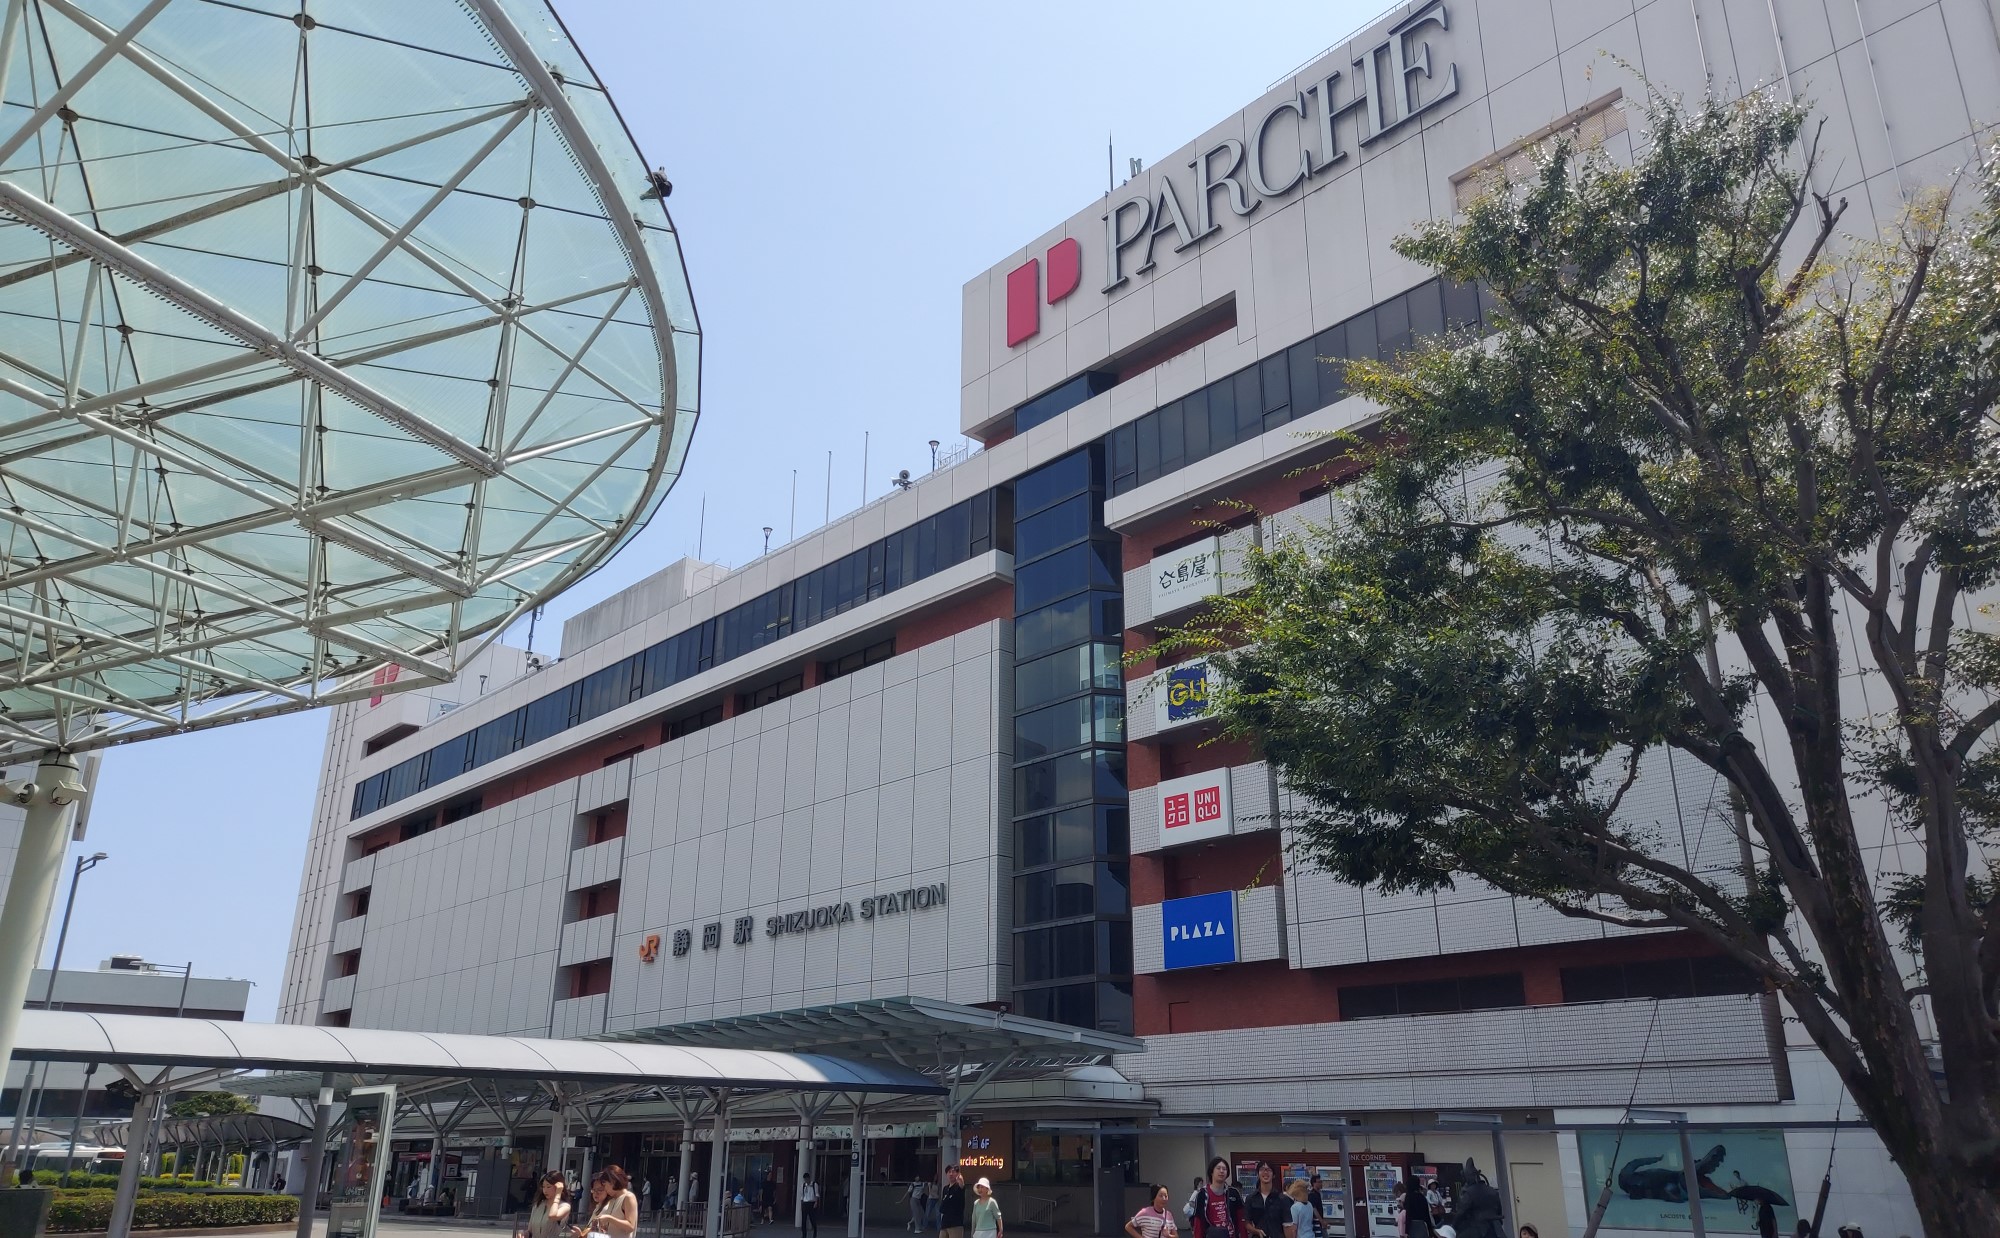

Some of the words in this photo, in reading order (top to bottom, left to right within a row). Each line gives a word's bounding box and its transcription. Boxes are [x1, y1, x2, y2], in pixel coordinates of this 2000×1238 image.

[1158, 555, 1207, 589] 谷島屋
[1169, 677, 1206, 707] GU
[1167, 797, 1186, 812] ユニ
[1197, 790, 1216, 805] UNI
[1167, 811, 1187, 825] クロ
[1197, 804, 1218, 820] QLO
[672, 914, 753, 957] 静岡駅
[765, 901, 855, 938] SHIZUOKA
[859, 883, 947, 919] STATION
[1170, 920, 1226, 941] PLAZA
[980, 1138, 990, 1150] 6F
[959, 1155, 978, 1167] arche
[979, 1155, 1004, 1169] Dining
[1361, 1154, 1387, 1162] CORNER
